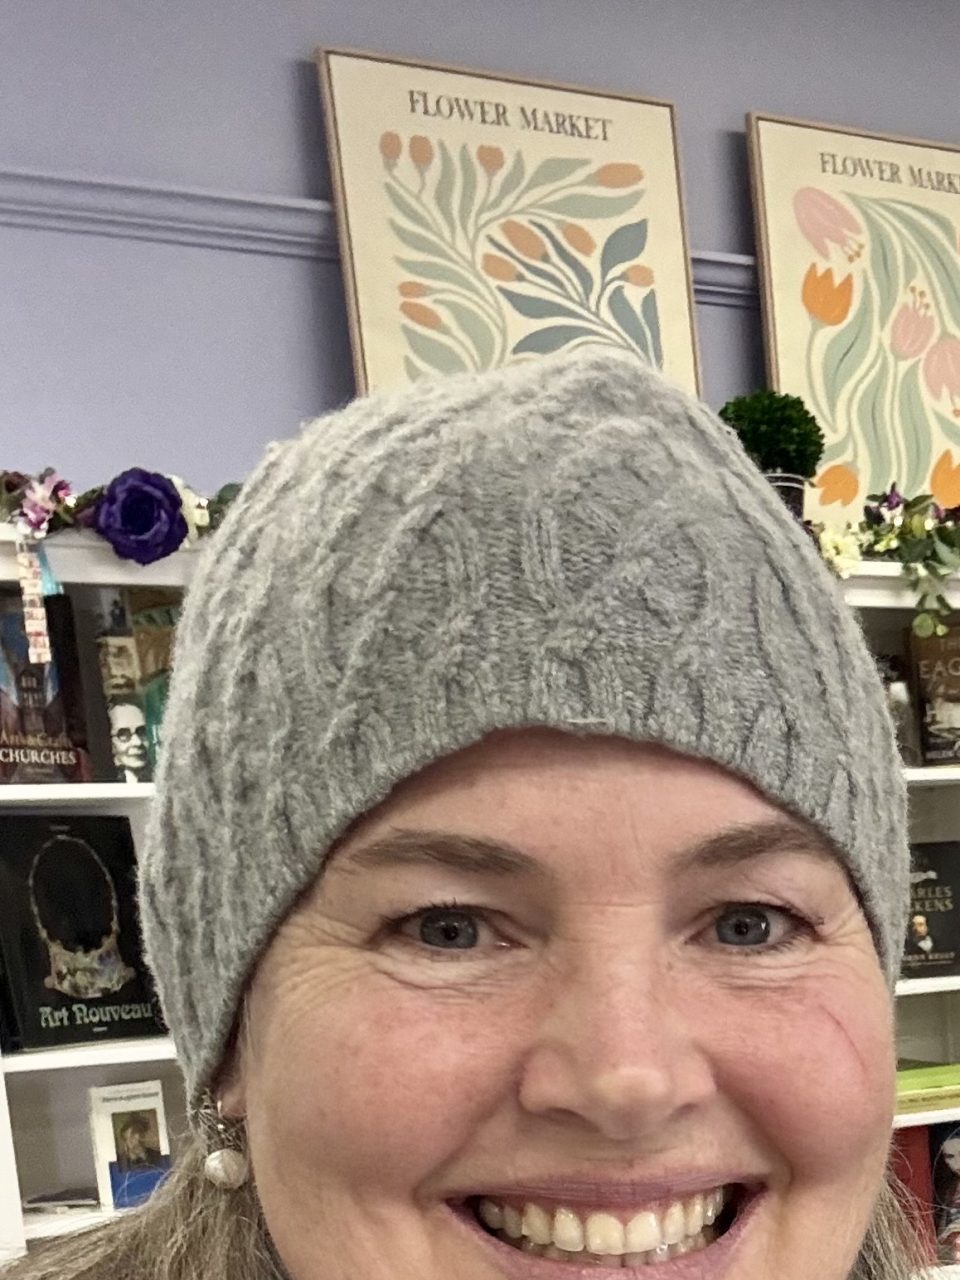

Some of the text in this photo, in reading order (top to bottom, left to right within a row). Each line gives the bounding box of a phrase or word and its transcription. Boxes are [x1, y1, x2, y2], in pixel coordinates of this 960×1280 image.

[408, 89, 613, 141] FLOWER MARKET
[819, 152, 902, 184] FLOWER
[0, 747, 77, 765] CHURCHES
[39, 1002, 153, 1028] Art Nouveau
